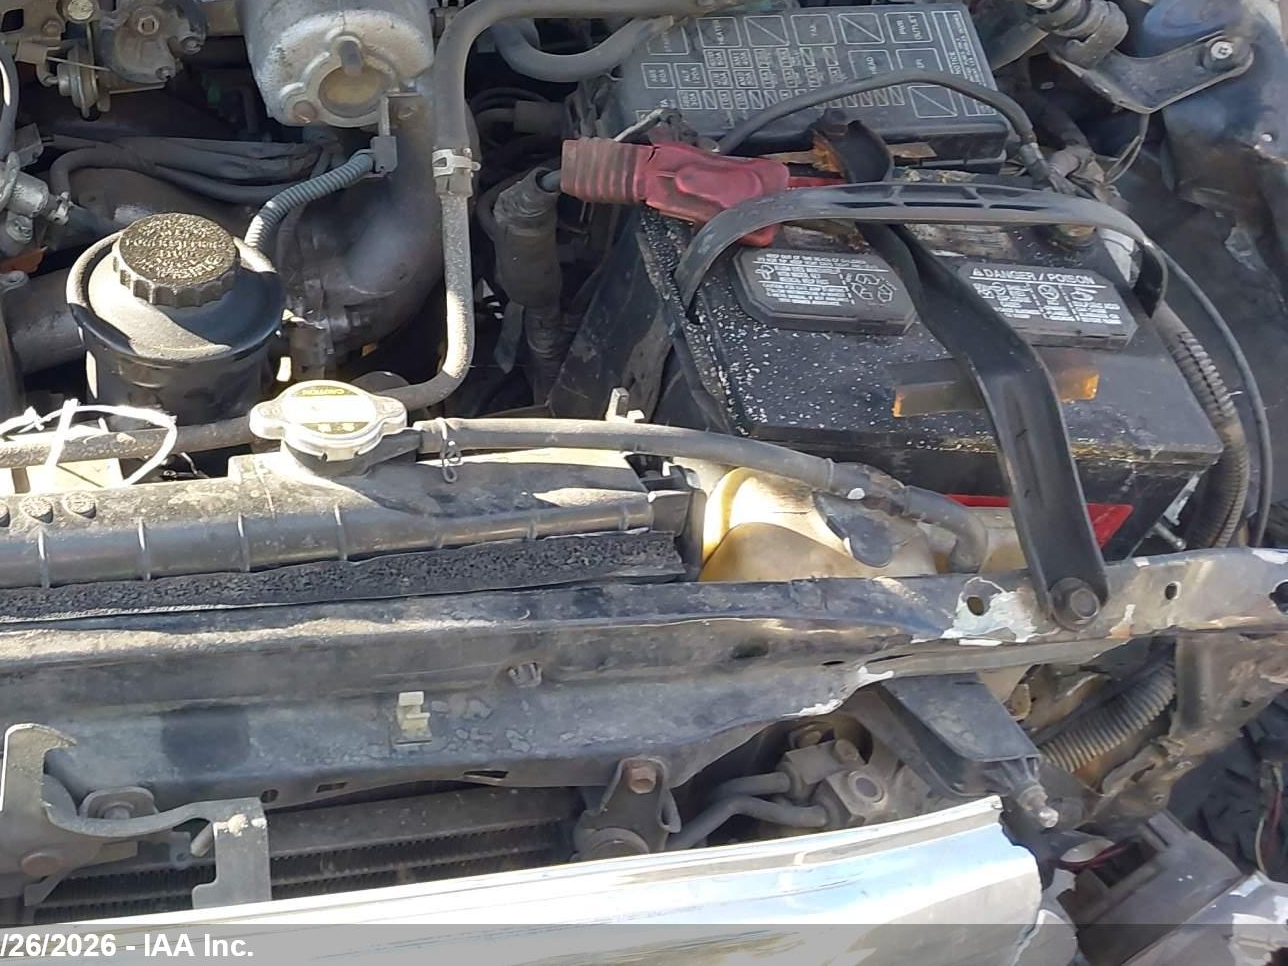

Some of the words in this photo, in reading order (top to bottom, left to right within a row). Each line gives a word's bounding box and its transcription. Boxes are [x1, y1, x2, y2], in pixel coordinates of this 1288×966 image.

[948, 51, 962, 75] NOTICE
[983, 268, 1037, 281] DANGER
[1047, 272, 1096, 285] POISON
